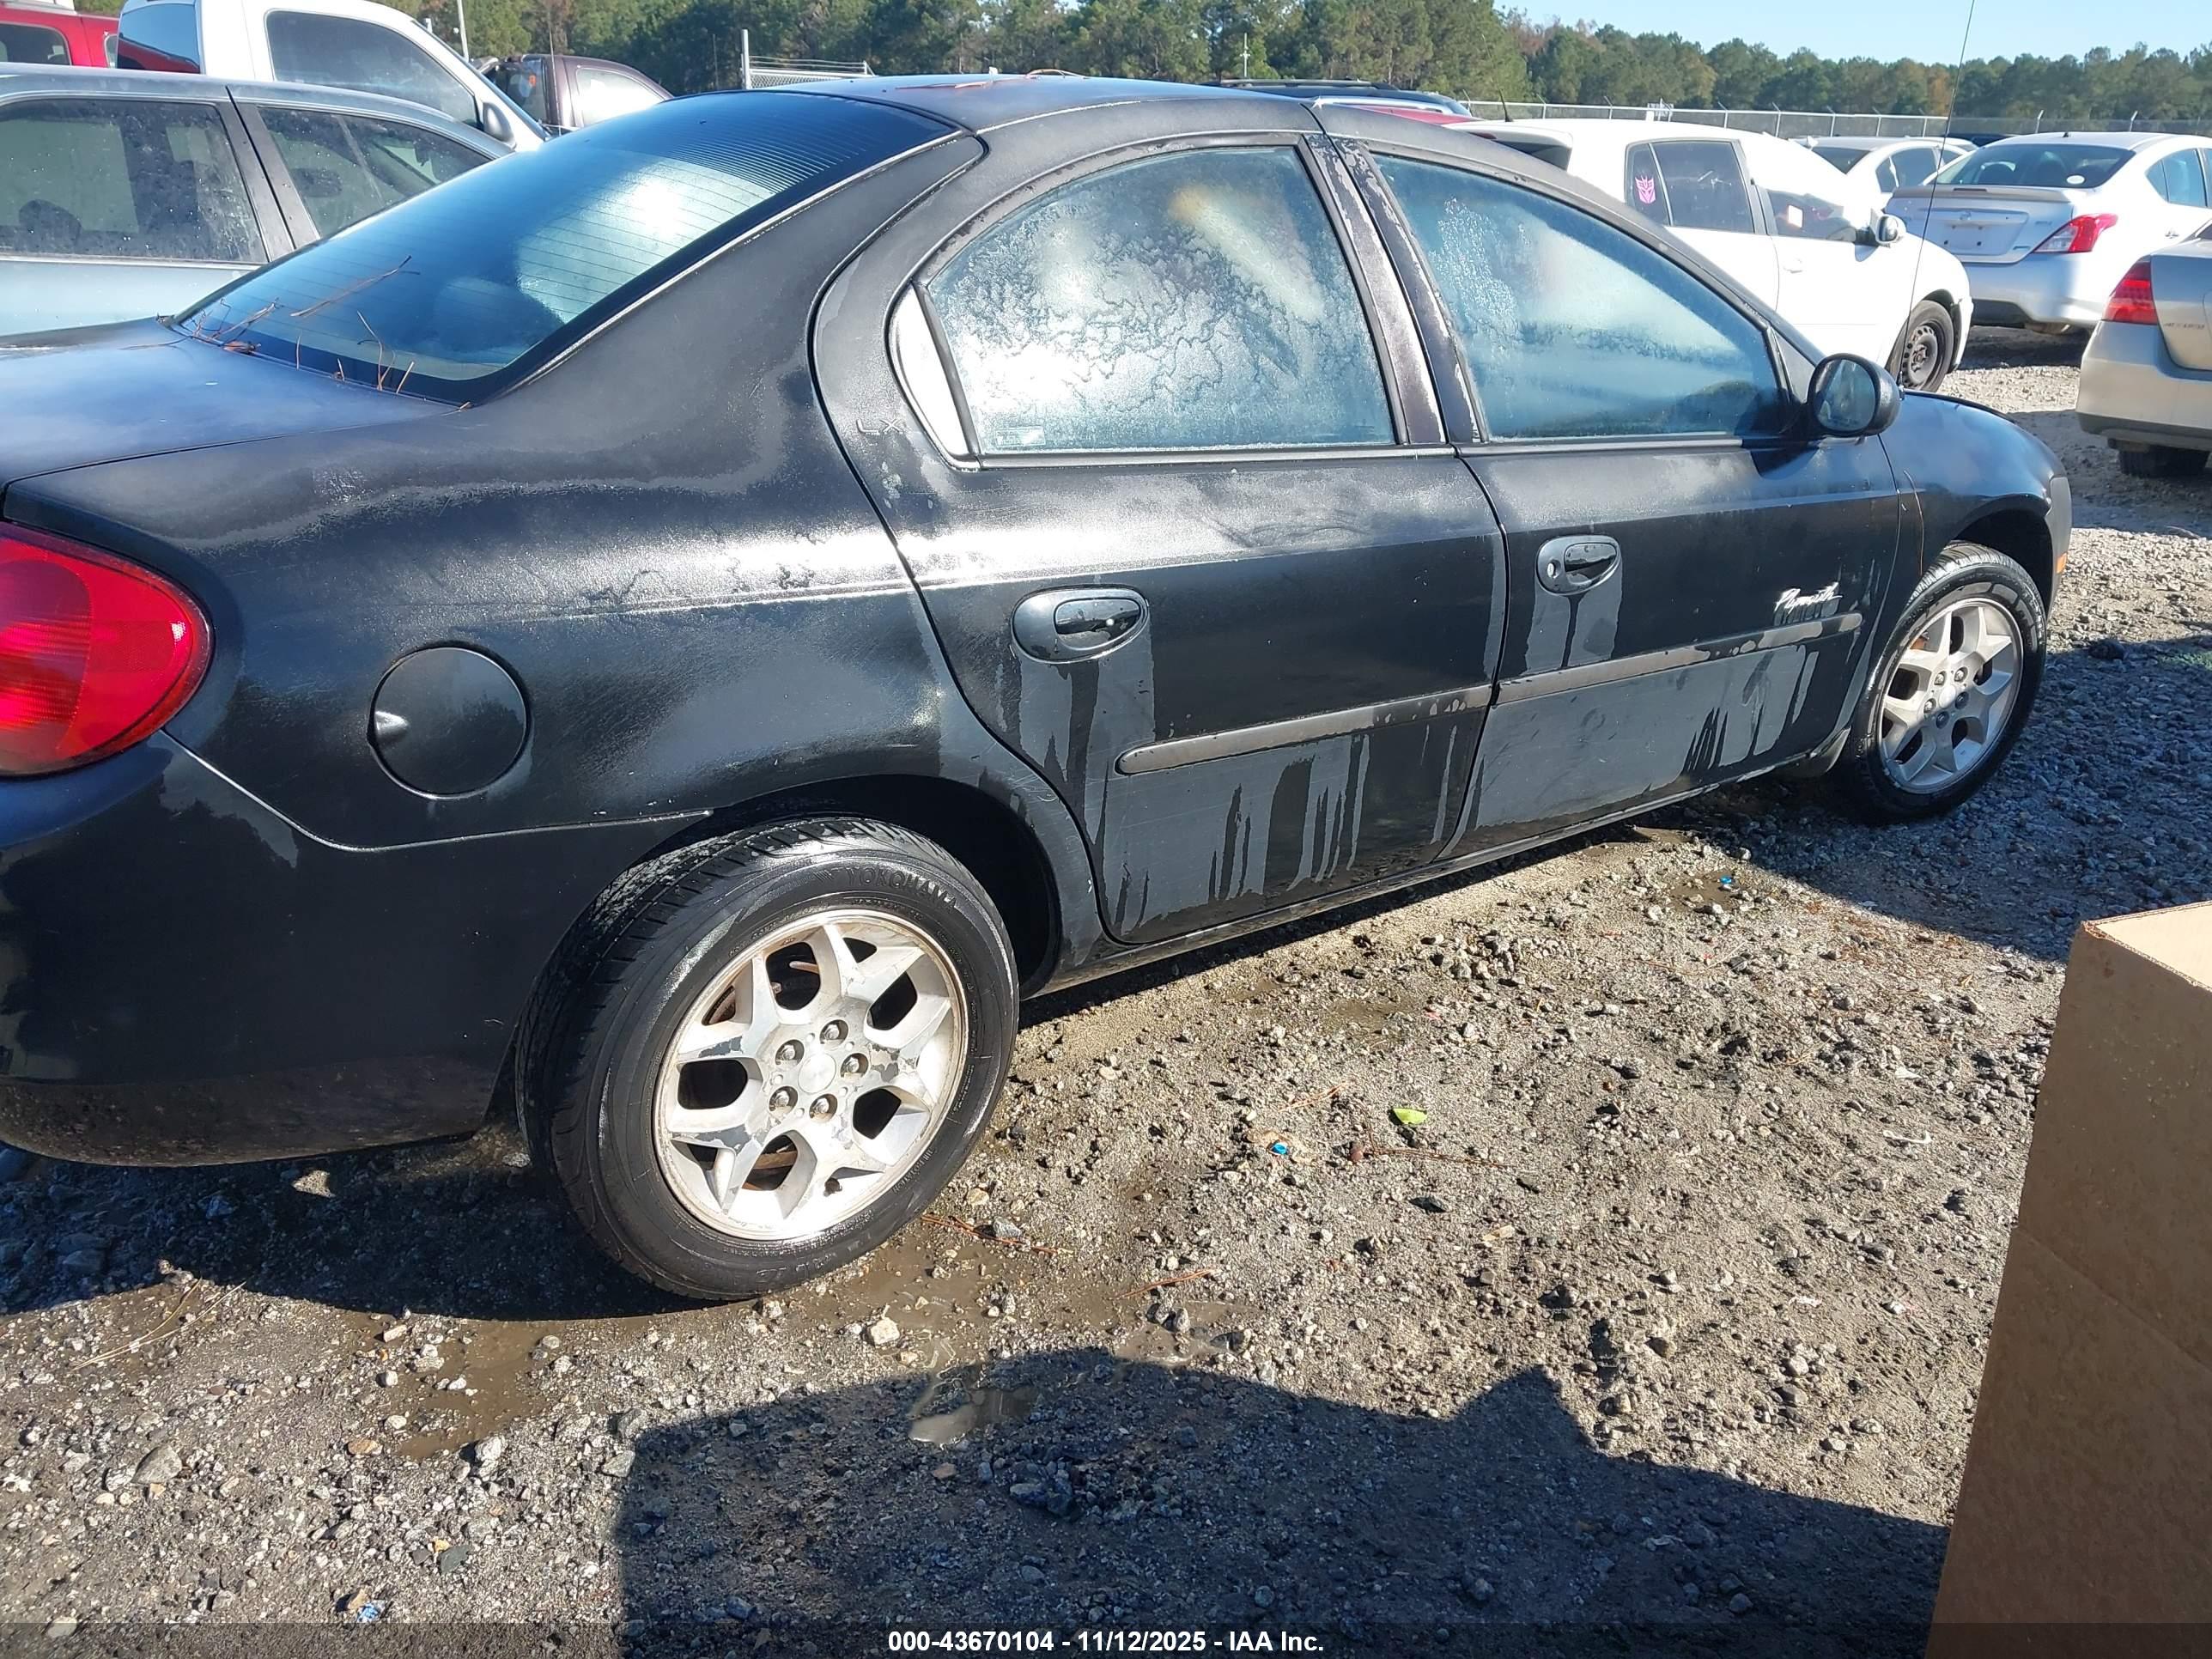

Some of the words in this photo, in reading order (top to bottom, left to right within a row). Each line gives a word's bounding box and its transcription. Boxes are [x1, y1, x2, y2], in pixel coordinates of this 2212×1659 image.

[856, 417, 902, 434] LX
[1774, 581, 1843, 615] Plymouth
[844, 866, 957, 911] YOKOHAMA
